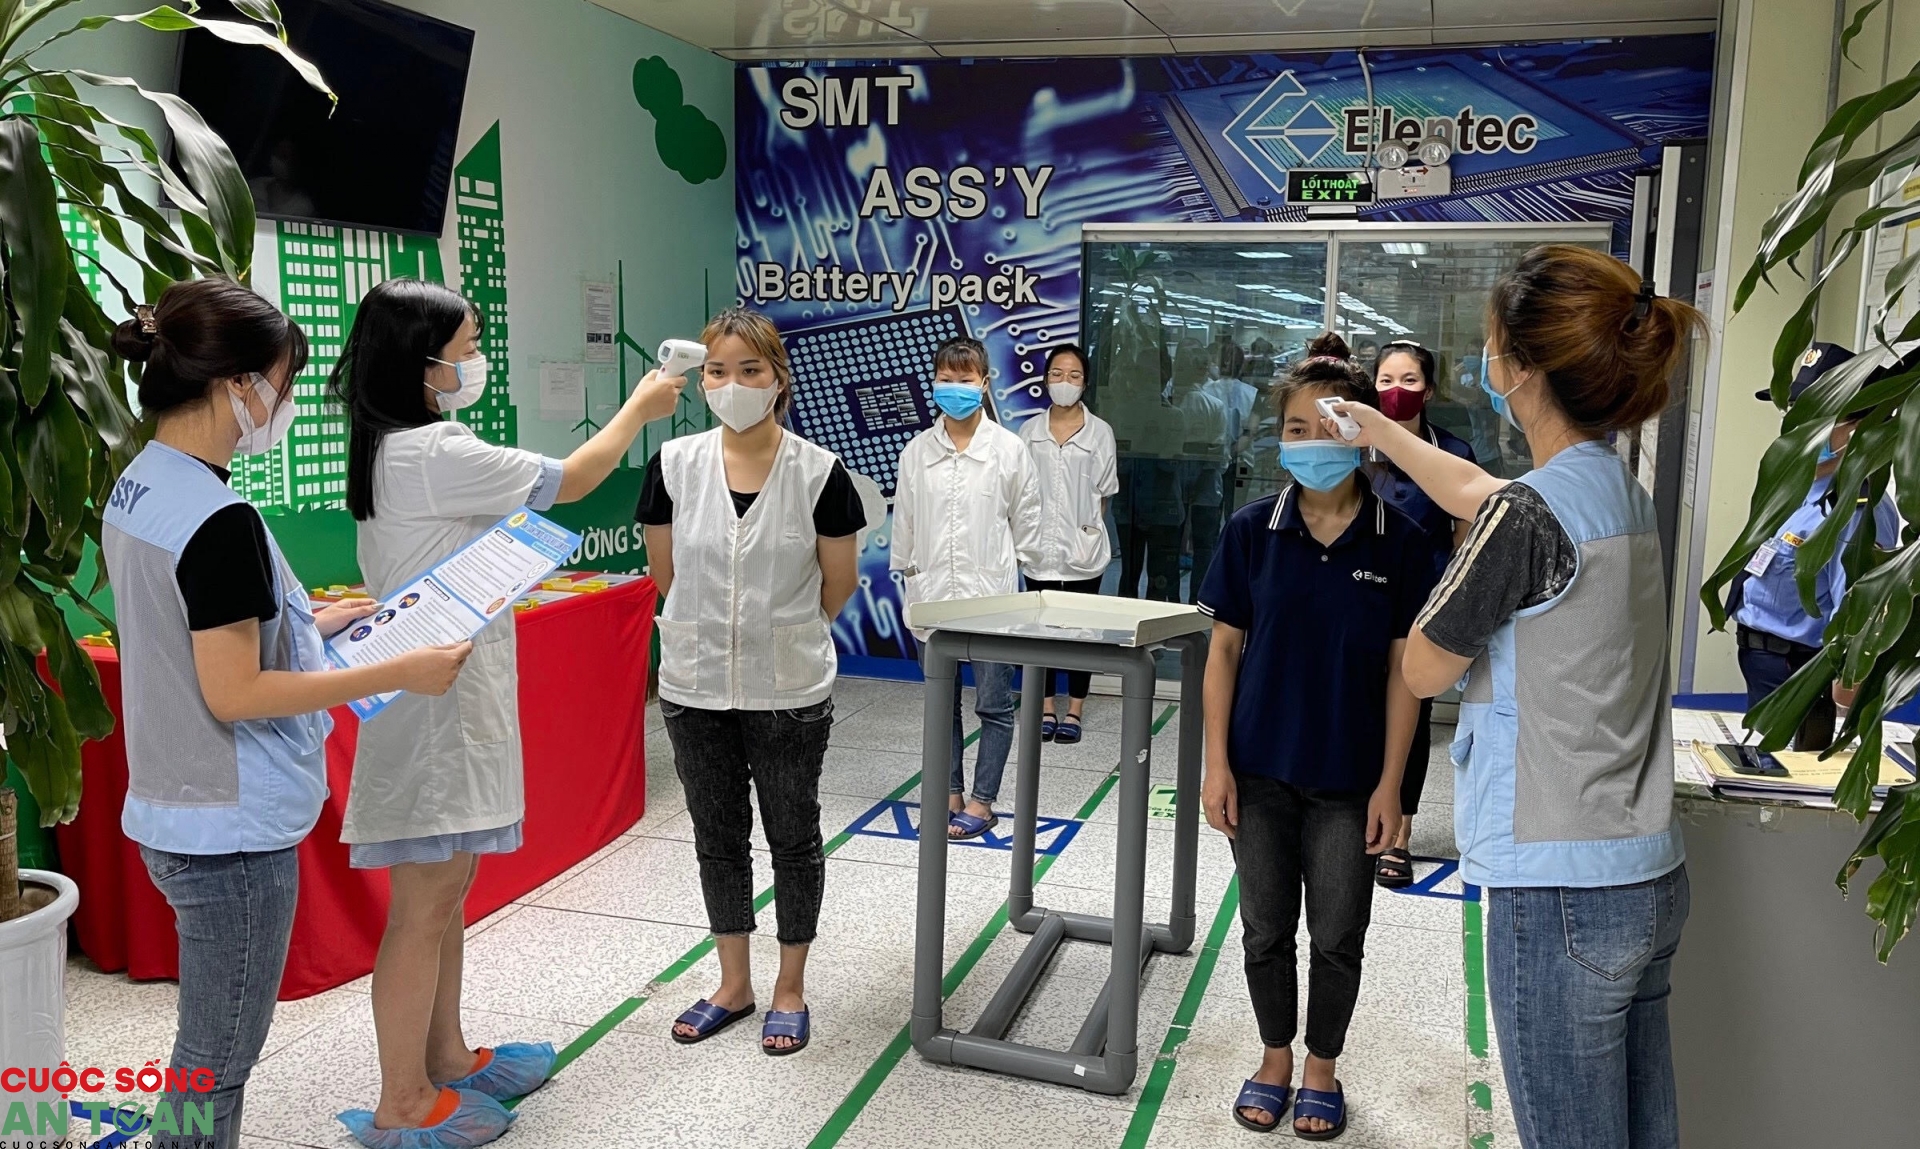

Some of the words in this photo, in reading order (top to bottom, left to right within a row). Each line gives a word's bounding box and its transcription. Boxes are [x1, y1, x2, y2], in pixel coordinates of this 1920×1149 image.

[780, 76, 913, 128] SMT
[1343, 105, 1537, 153] Elentec
[859, 166, 1054, 218] ASS'Y
[1302, 174, 1320, 189] LỐI
[1302, 190, 1358, 200] EXIT
[757, 263, 916, 310] Battery
[931, 266, 1041, 311] pack
[110, 476, 151, 515] SSY
[562, 525, 628, 567] ƯỜNG
